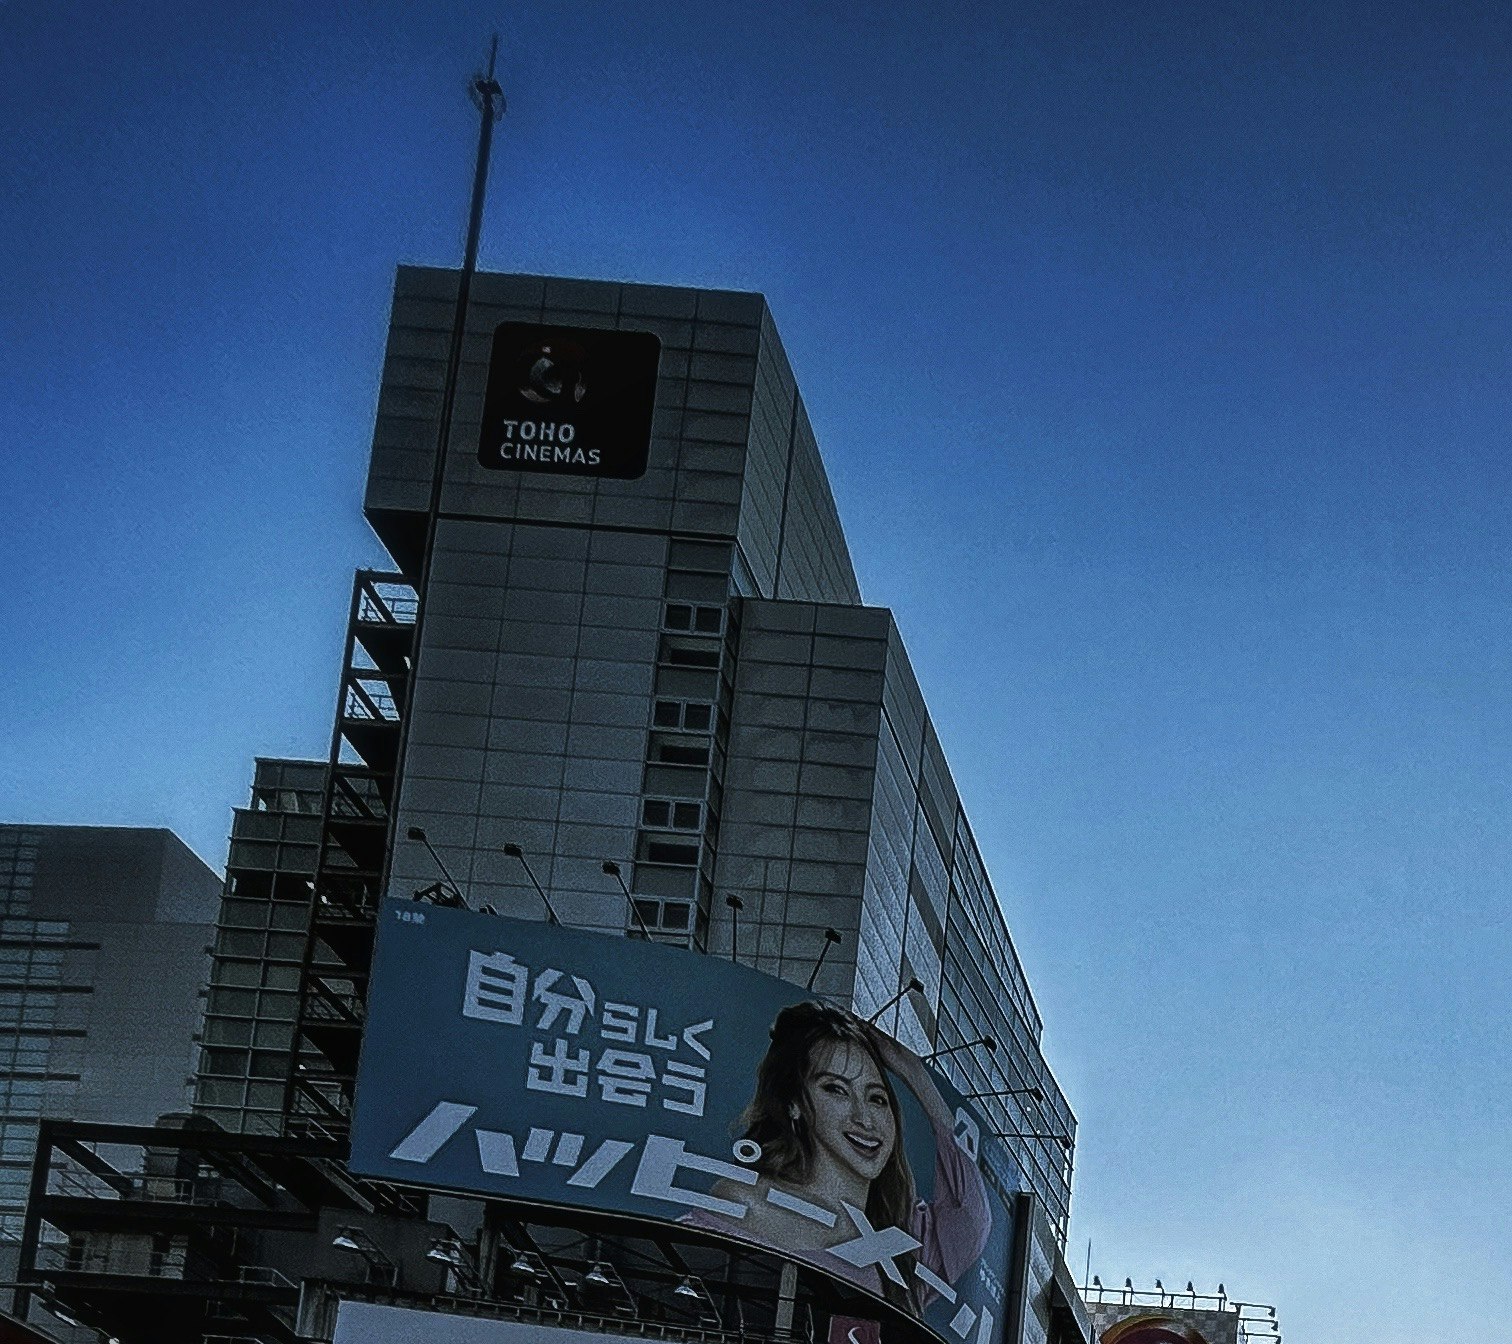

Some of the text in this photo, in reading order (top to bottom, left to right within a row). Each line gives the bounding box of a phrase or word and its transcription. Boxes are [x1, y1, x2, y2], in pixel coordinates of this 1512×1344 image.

[500, 442, 601, 465] CINEMAS
[502, 419, 576, 443] TOHO
[462, 947, 716, 1062] 自分らしく
[526, 1036, 707, 1118] 出会う
